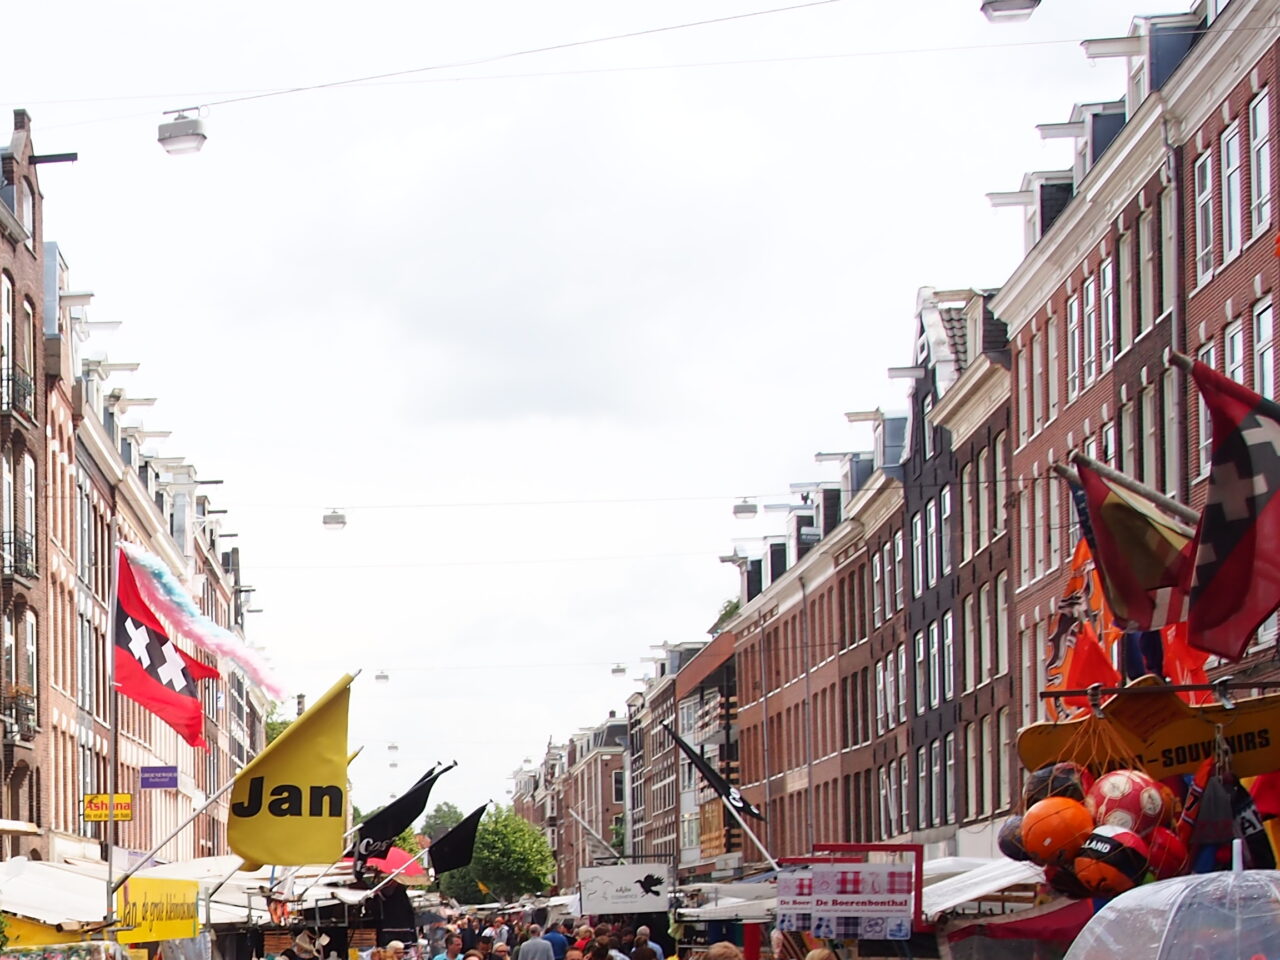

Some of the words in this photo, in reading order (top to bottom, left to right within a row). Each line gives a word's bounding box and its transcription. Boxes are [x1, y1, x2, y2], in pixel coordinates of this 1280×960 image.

[1161, 728, 1270, 768] SOUVNIRS
[231, 776, 343, 818] Jan
[84, 799, 130, 812] Ashna
[1081, 839, 1111, 853] LAND
[815, 898, 829, 907] De
[831, 898, 908, 907] Boerenbonthal
